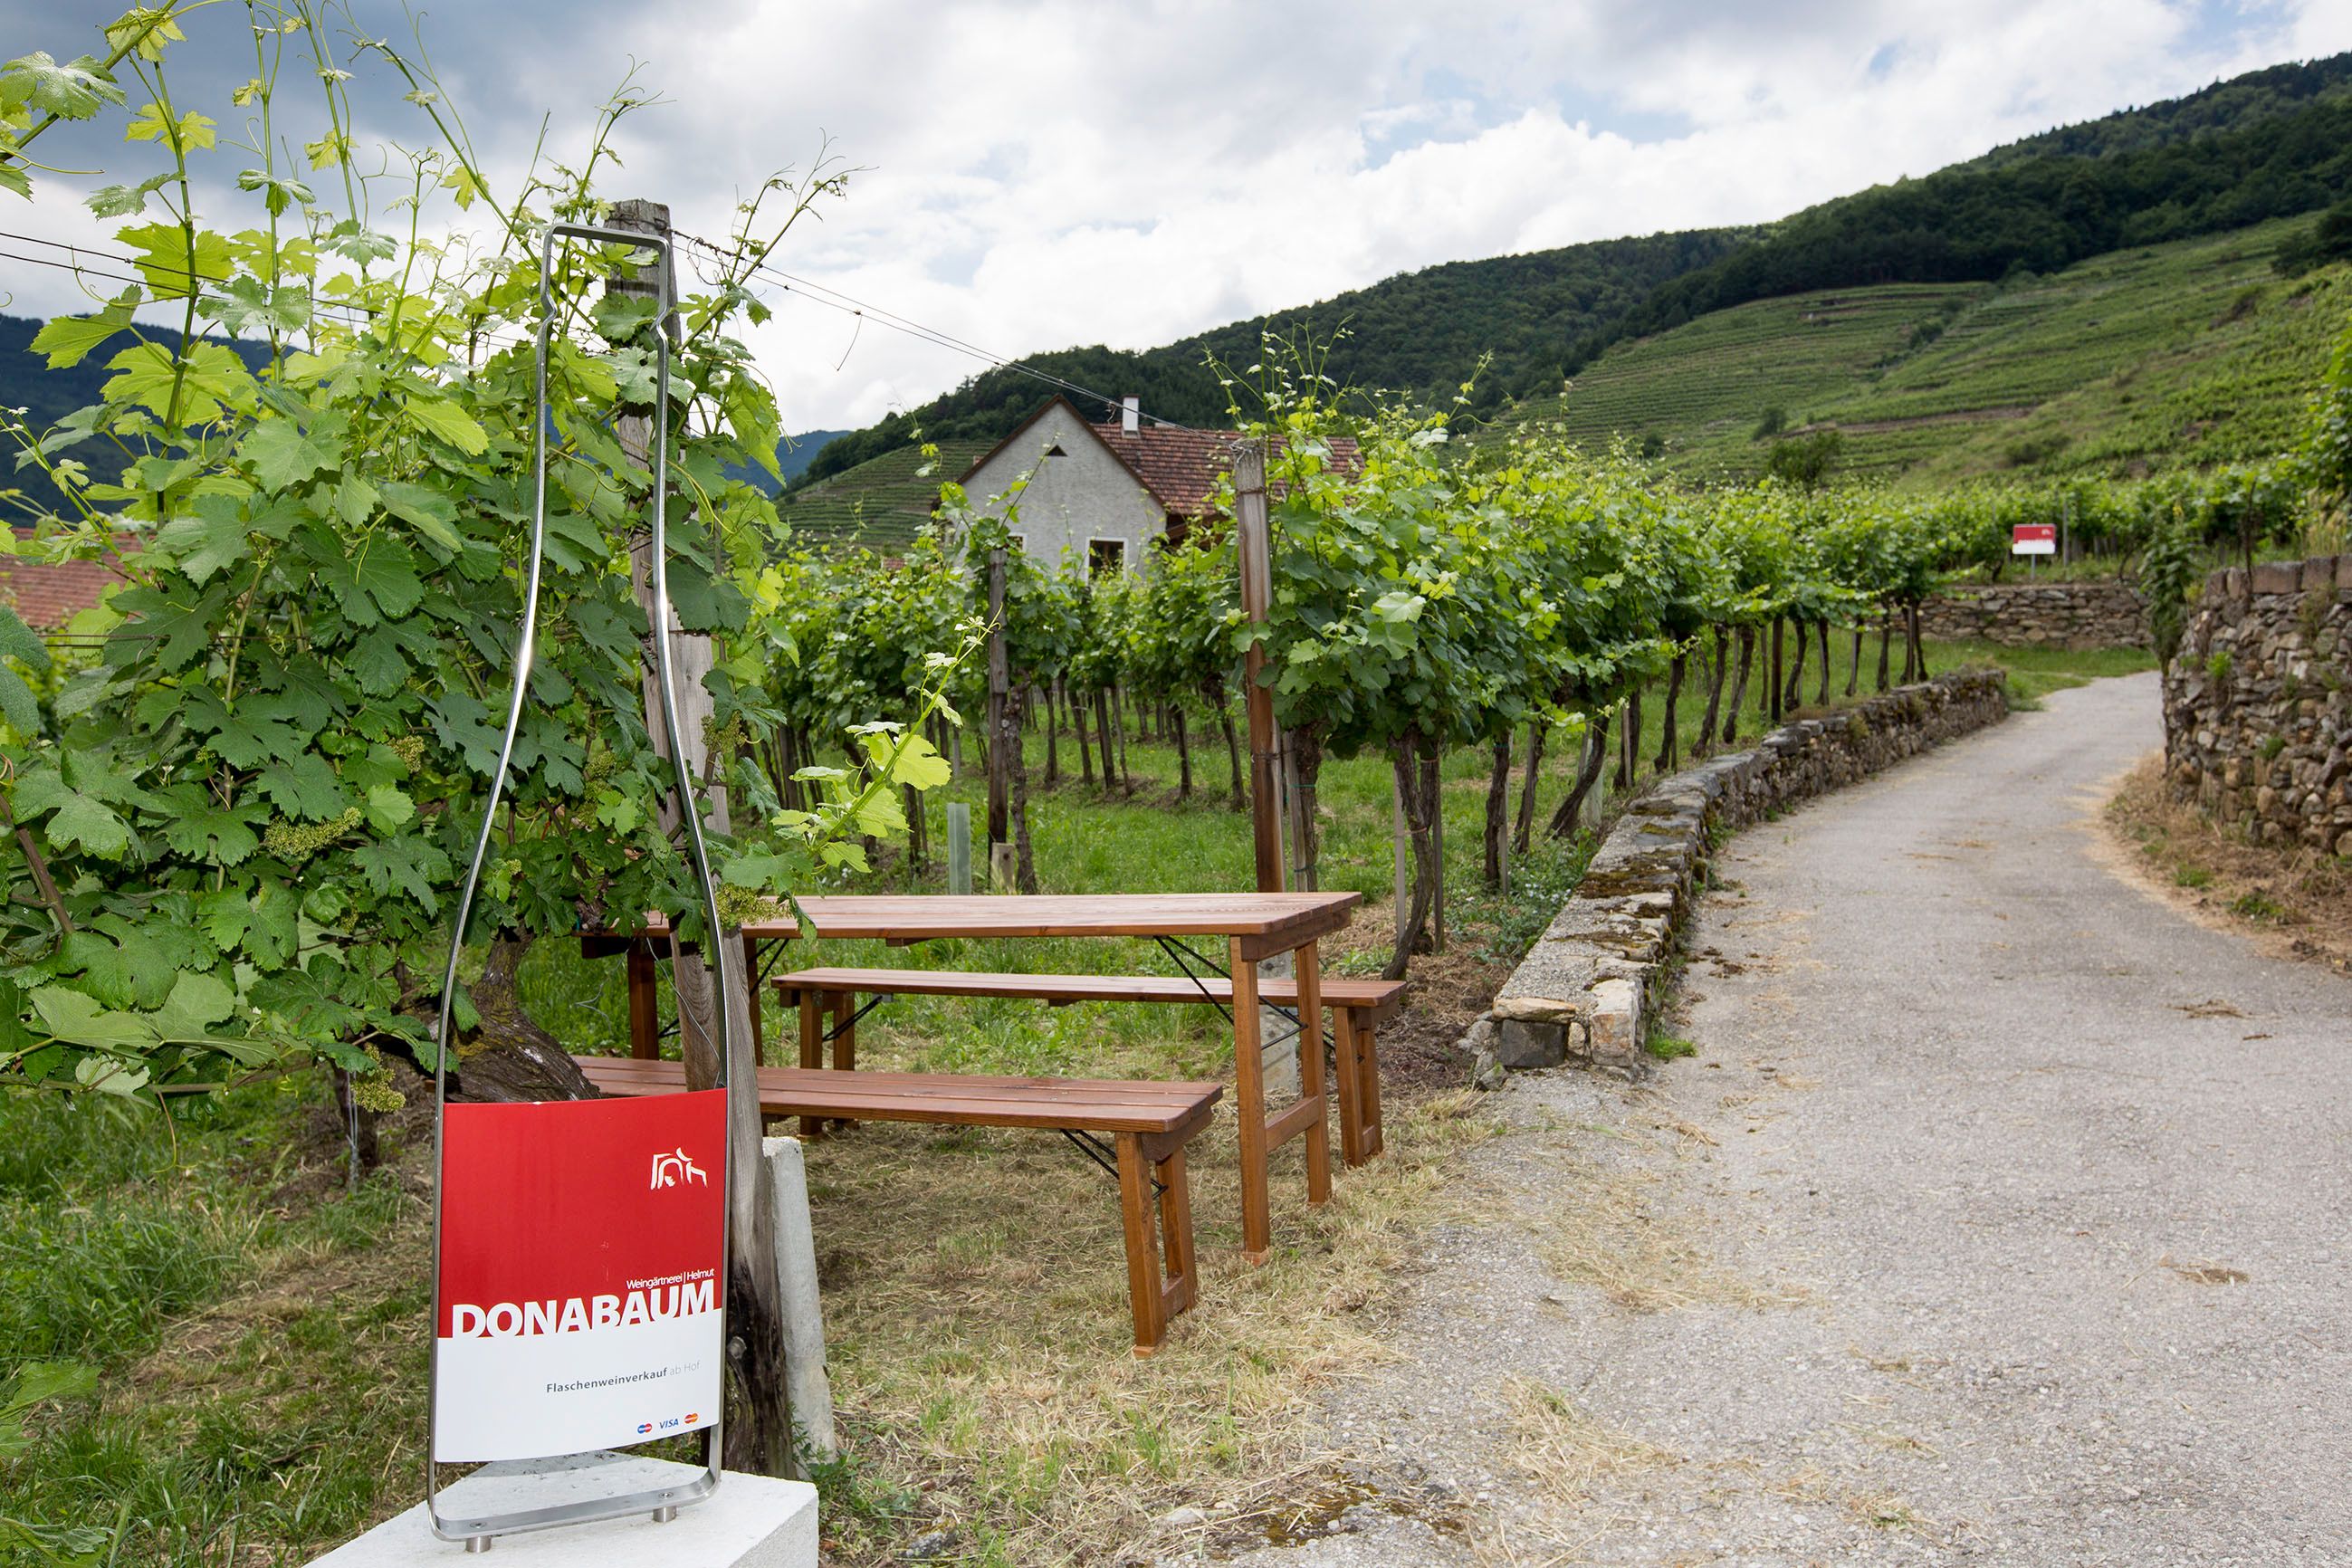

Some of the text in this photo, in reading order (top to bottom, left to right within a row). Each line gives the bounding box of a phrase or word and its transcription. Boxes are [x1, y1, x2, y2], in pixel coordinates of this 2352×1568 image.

[626, 1268, 715, 1289] Weingärtnerei Helmut
[452, 1278, 714, 1340] DONABAUM
[546, 1360, 701, 1393] Flaschenweinverkauf ab Hof
[659, 1418, 679, 1429] VISA
